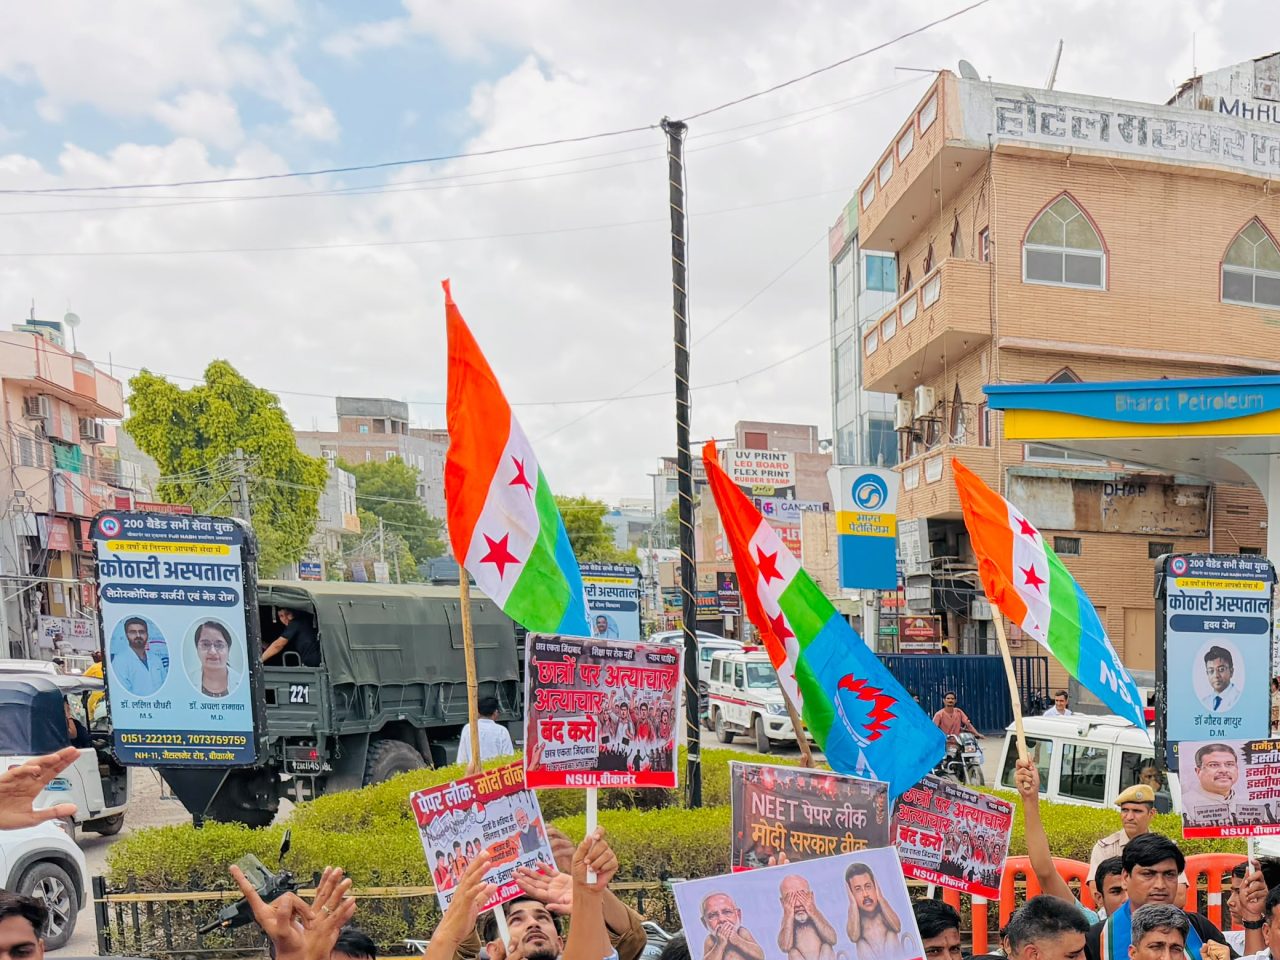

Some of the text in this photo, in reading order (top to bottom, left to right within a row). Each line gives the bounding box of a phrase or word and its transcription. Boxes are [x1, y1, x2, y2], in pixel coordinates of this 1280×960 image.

[1115, 392, 1264, 412] Bharat Petroleum
[735, 451, 787, 461] UV PRINT
[756, 461, 789, 469] BOARD
[761, 470, 790, 478] PRINT
[856, 514, 882, 523] भारत
[124, 519, 144, 529] 200
[170, 519, 189, 530] सभी
[191, 520, 212, 531] सेवा
[213, 523, 234, 535] युक्त
[99, 554, 241, 582] कोठारी अस्पताल
[1189, 559, 1204, 568] 200
[1223, 560, 1237, 570] सभी
[218, 591, 235, 602] रोग
[598, 586, 638, 598] अस्पताल
[1168, 590, 1270, 613] कोठारी अस्पताल
[1221, 619, 1236, 630] रोग
[580, 663, 601, 687] पर
[605, 665, 674, 692] अत्याचार
[290, 685, 309, 703] 221
[534, 689, 603, 714] अत्याचार
[540, 714, 597, 744] बंद करो
[1204, 715, 1222, 726] गौरव
[1223, 717, 1242, 729] माथुर
[121, 734, 246, 745] 0151-2221212, 7073759759
[134, 751, 161, 760] NH-11,
[557, 748, 573, 758] एकता
[565, 773, 637, 787] NSUI,बीकानेर
[417, 792, 444, 814] पेपर
[475, 769, 502, 796] मोदी
[752, 791, 868, 830] NEET पेपर लीक
[935, 796, 952, 814] पर
[953, 802, 1008, 833] अत्याचार
[897, 805, 952, 834] अत्याचार
[751, 818, 787, 851] मोदी
[789, 830, 838, 856] सरकार
[899, 826, 944, 852] बंद करो
